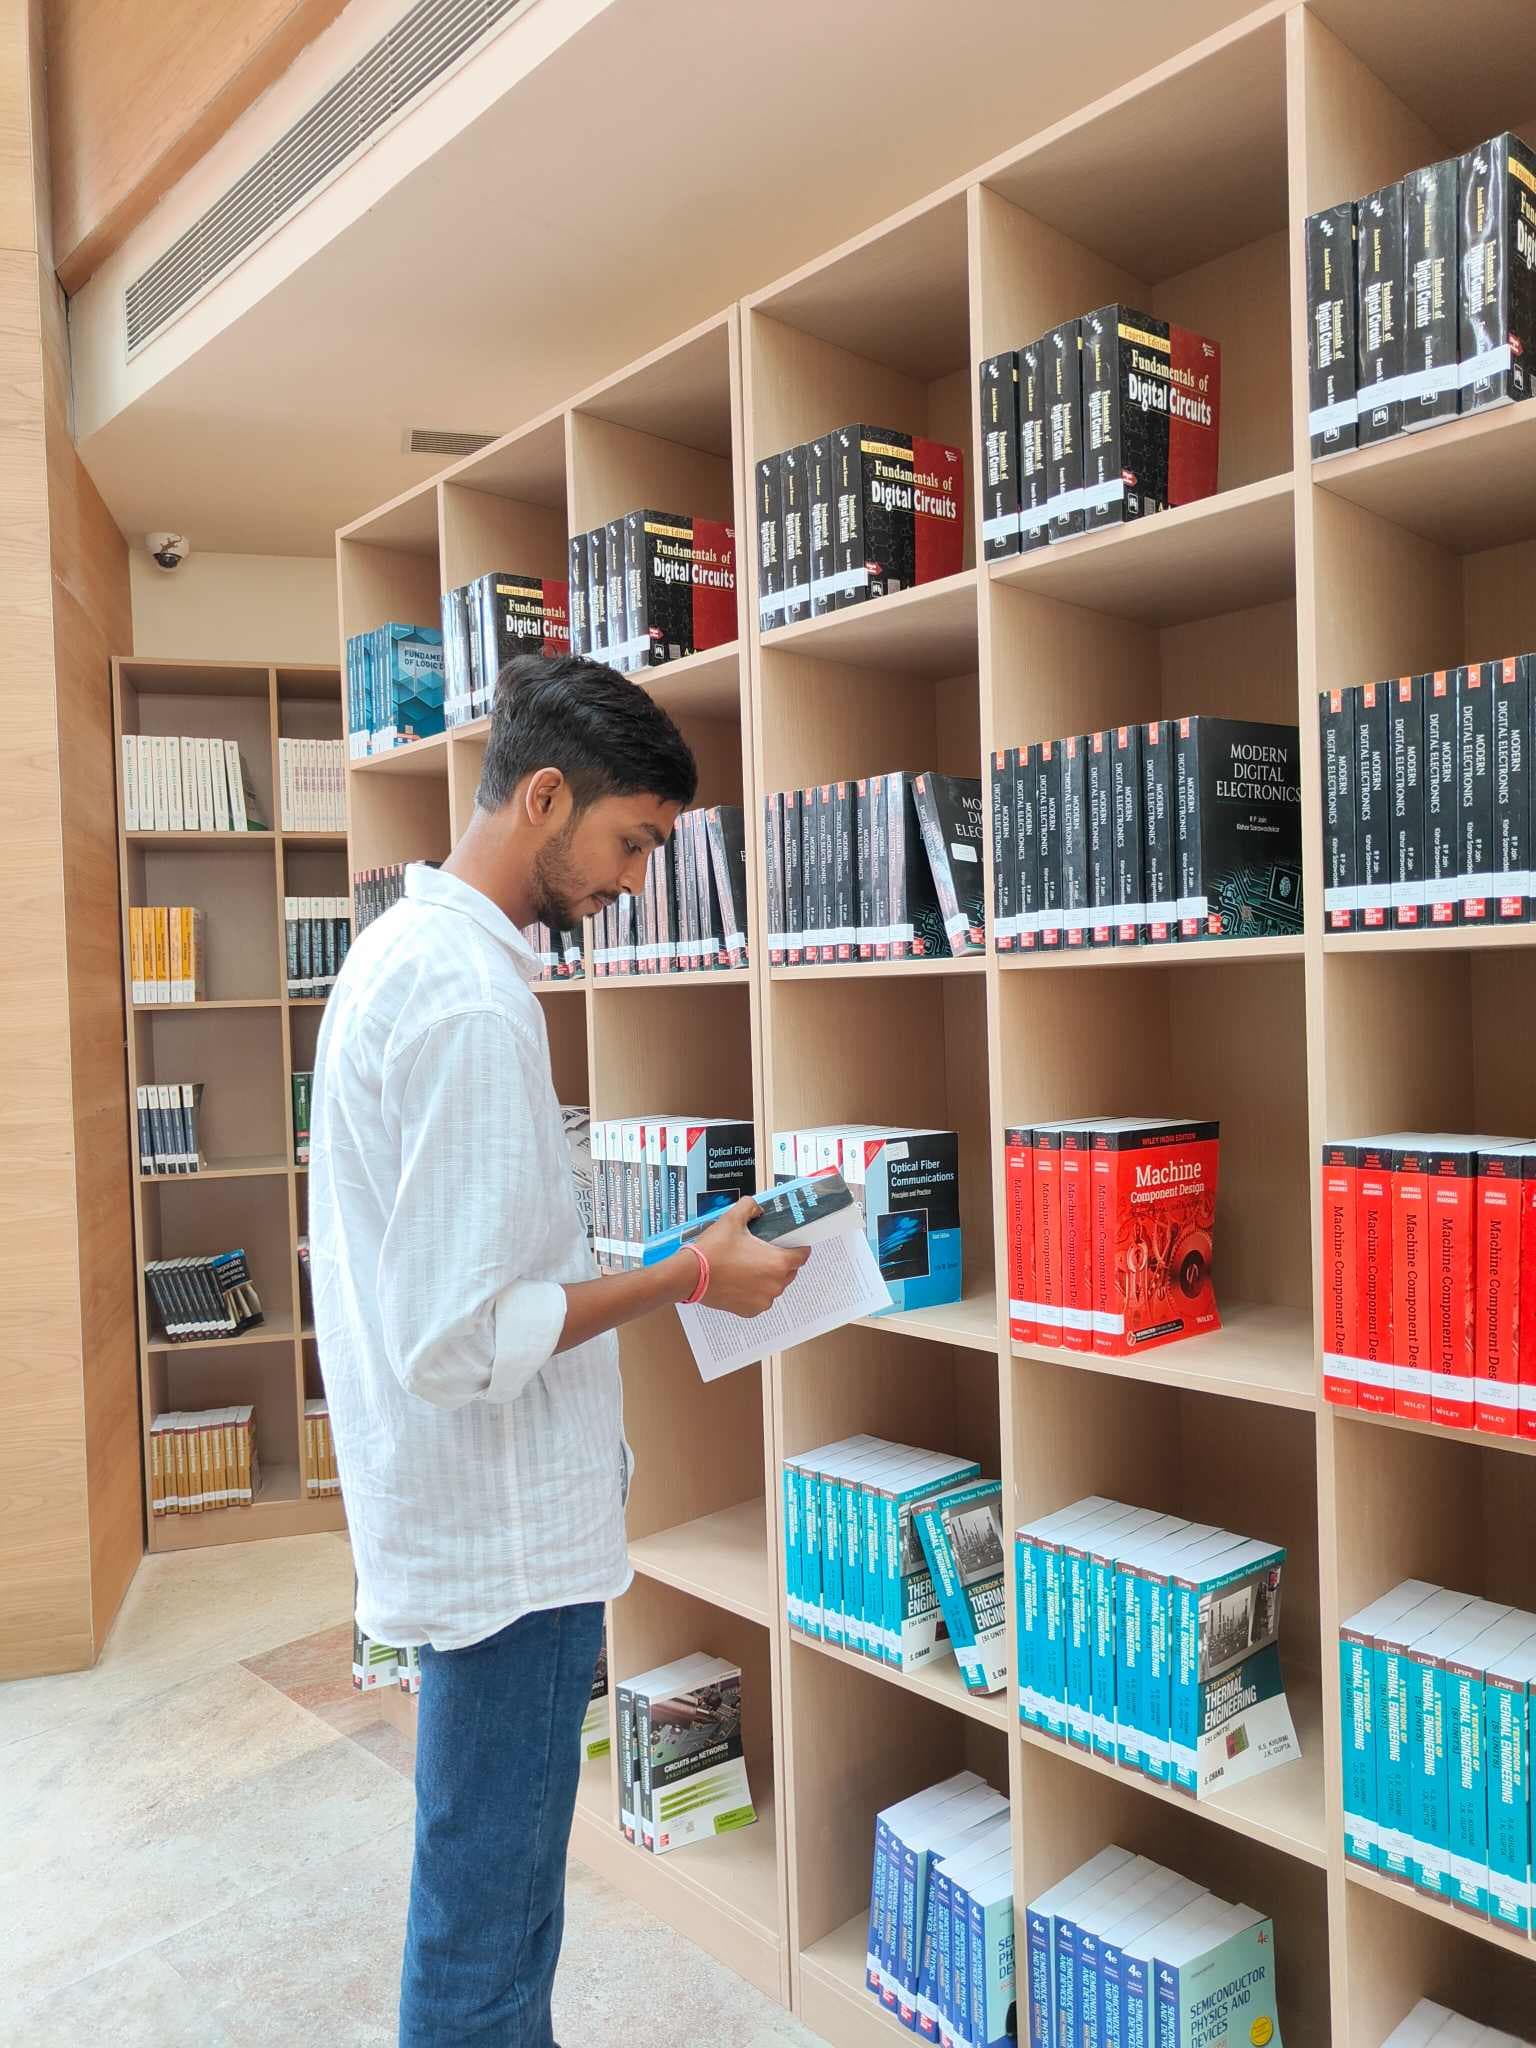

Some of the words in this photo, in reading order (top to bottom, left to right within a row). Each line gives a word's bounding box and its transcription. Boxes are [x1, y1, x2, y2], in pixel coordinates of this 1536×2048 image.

[1412, 259, 1431, 290] Digital
[1315, 301, 1332, 331] Digital
[1365, 282, 1381, 312] Digital
[1417, 290, 1431, 328] Circuits
[1319, 331, 1332, 368] Circuits
[1368, 313, 1382, 350] Circuits
[1131, 348, 1195, 388] Fundamentals
[1199, 374, 1210, 392] of
[1128, 373, 1168, 411] Digital
[1169, 387, 1212, 426] Circuits
[874, 460, 939, 488] Fundamentals
[943, 476, 953, 491] of
[871, 480, 912, 512] Digital
[914, 489, 957, 519] Circuits
[656, 539, 717, 562] Fundamentals
[722, 551, 732, 565] of
[654, 557, 689, 585] Digital
[692, 564, 734, 589] Circuits
[506, 614, 541, 638] Digital
[508, 599, 566, 618] Fundamentals
[1395, 718, 1404, 755] DIGITAL
[1430, 713, 1439, 750] DIGITAL
[1463, 706, 1473, 743] DIGITAL
[1498, 701, 1508, 739] DIGITAL
[1230, 744, 1288, 764] MODERN
[1326, 729, 1336, 766] DIGITAL
[1360, 724, 1369, 760] DIGITAL
[1476, 734, 1486, 776] MODERN
[1511, 729, 1521, 772] MODERN
[1234, 762, 1285, 782] DIGITAL
[1338, 756, 1348, 795] MODERN
[1372, 751, 1381, 791] MODERN
[1407, 746, 1417, 787] MODERN
[1442, 742, 1451, 783] MODERN
[1464, 744, 1473, 808] ELECTRONICS
[1498, 740, 1509, 805] ELECTRONICS
[1091, 767, 1099, 799] DIGITAL
[1156, 784, 1164, 819] MODERN
[1187, 777, 1195, 813] MODERN
[1216, 780, 1301, 802] ELECTRONICS
[1327, 766, 1337, 825] ELECTRONICS
[1361, 760, 1371, 822] ELECTRONICS
[1396, 756, 1405, 818] ELECTRONICS
[1430, 751, 1440, 814] ELECTRONICS
[1091, 799, 1099, 851] ELECTRONICS
[1116, 795, 1124, 848] ELECTRONICS
[1178, 787, 1186, 840] ELECTRONICS
[709, 1147, 733, 1159] Optical
[734, 1146, 752, 1155] Fiber
[890, 1160, 919, 1175] Optical
[920, 1159, 941, 1171] Fiber
[891, 1172, 955, 1187] Communications
[1135, 1159, 1202, 1188] Machine
[1130, 1185, 1178, 1204] Component
[1179, 1182, 1205, 1195] Design
[1334, 1206, 1345, 1258] Machine
[1367, 1210, 1379, 1263] Machine
[1406, 1214, 1418, 1267] Machine
[1442, 1217, 1454, 1273] Machine
[1489, 1220, 1502, 1276] Machine
[1333, 1259, 1345, 1329] Component
[1366, 1265, 1379, 1337] Component
[1405, 1271, 1419, 1342] Component
[1440, 1275, 1454, 1349] Component
[1487, 1279, 1500, 1355] Component
[1329, 1385, 1352, 1394] WILEY
[1363, 1392, 1384, 1401] WILEY
[1403, 1400, 1426, 1409] WILEY
[1436, 1407, 1460, 1418] WILEY
[1481, 1412, 1505, 1423] WILEY
[924, 1513, 939, 1549] THERMAL
[934, 1548, 954, 1597] ENGINEERING
[1126, 1578, 1134, 1613] THERMAL
[1181, 1591, 1190, 1629] THERMAL
[915, 1647, 930, 1659] CHAND
[1126, 1615, 1136, 1668] ENGINEERING
[1152, 1624, 1160, 1679] ENGINEERING
[1181, 1631, 1190, 1686] ENGINEERING
[1352, 1648, 1363, 1690] THERMAL
[1387, 1657, 1399, 1699] THERMAL
[1204, 1685, 1257, 1731] ENGINEERING
[1205, 1675, 1243, 1712] THERMAL
[1422, 1669, 1434, 1711] THERMAL
[1459, 1680, 1470, 1724] THERMAL
[1354, 1691, 1365, 1751] ENGINEERING
[1388, 1699, 1401, 1762] ENGINEERING
[1434, 1700, 1442, 1745] TEXTBOOK
[1500, 1693, 1511, 1737] THERMAL
[1424, 1713, 1435, 1776] ENGINEERING
[1436, 1746, 1443, 1758] OF
[1472, 1712, 1480, 1758] TEXTBOOK
[1513, 1726, 1521, 1772] TEXTBOOK
[664, 1758, 690, 1773] CIRCUITS
[699, 1742, 729, 1760] NETWORKS
[1209, 1767, 1225, 1782] CHAND
[1460, 1725, 1473, 1790] ENGINEERING
[1472, 1759, 1480, 1772] OF
[1501, 1739, 1513, 1805] ENGINEERING
[1513, 1773, 1521, 1786] OF
[905, 1854, 914, 1866] 4e
[939, 1878, 948, 1891] 4e
[954, 1890, 965, 1904] 4e
[971, 1906, 981, 1919] 4e
[1032, 1920, 1045, 1933] 4e
[1060, 1925, 1073, 1938] 4e
[1082, 1937, 1096, 1951] 4e
[1105, 1950, 1118, 1964] 4e
[1128, 1964, 1142, 1978] 4e
[1160, 1970, 1174, 1984] 4e
[1190, 1966, 1265, 2019] SEMICONDUCTOR
[1191, 2001, 1228, 2035] PHYSICS
[1231, 1990, 1251, 2010] AND
[1191, 2019, 1228, 2048] DEVICES
